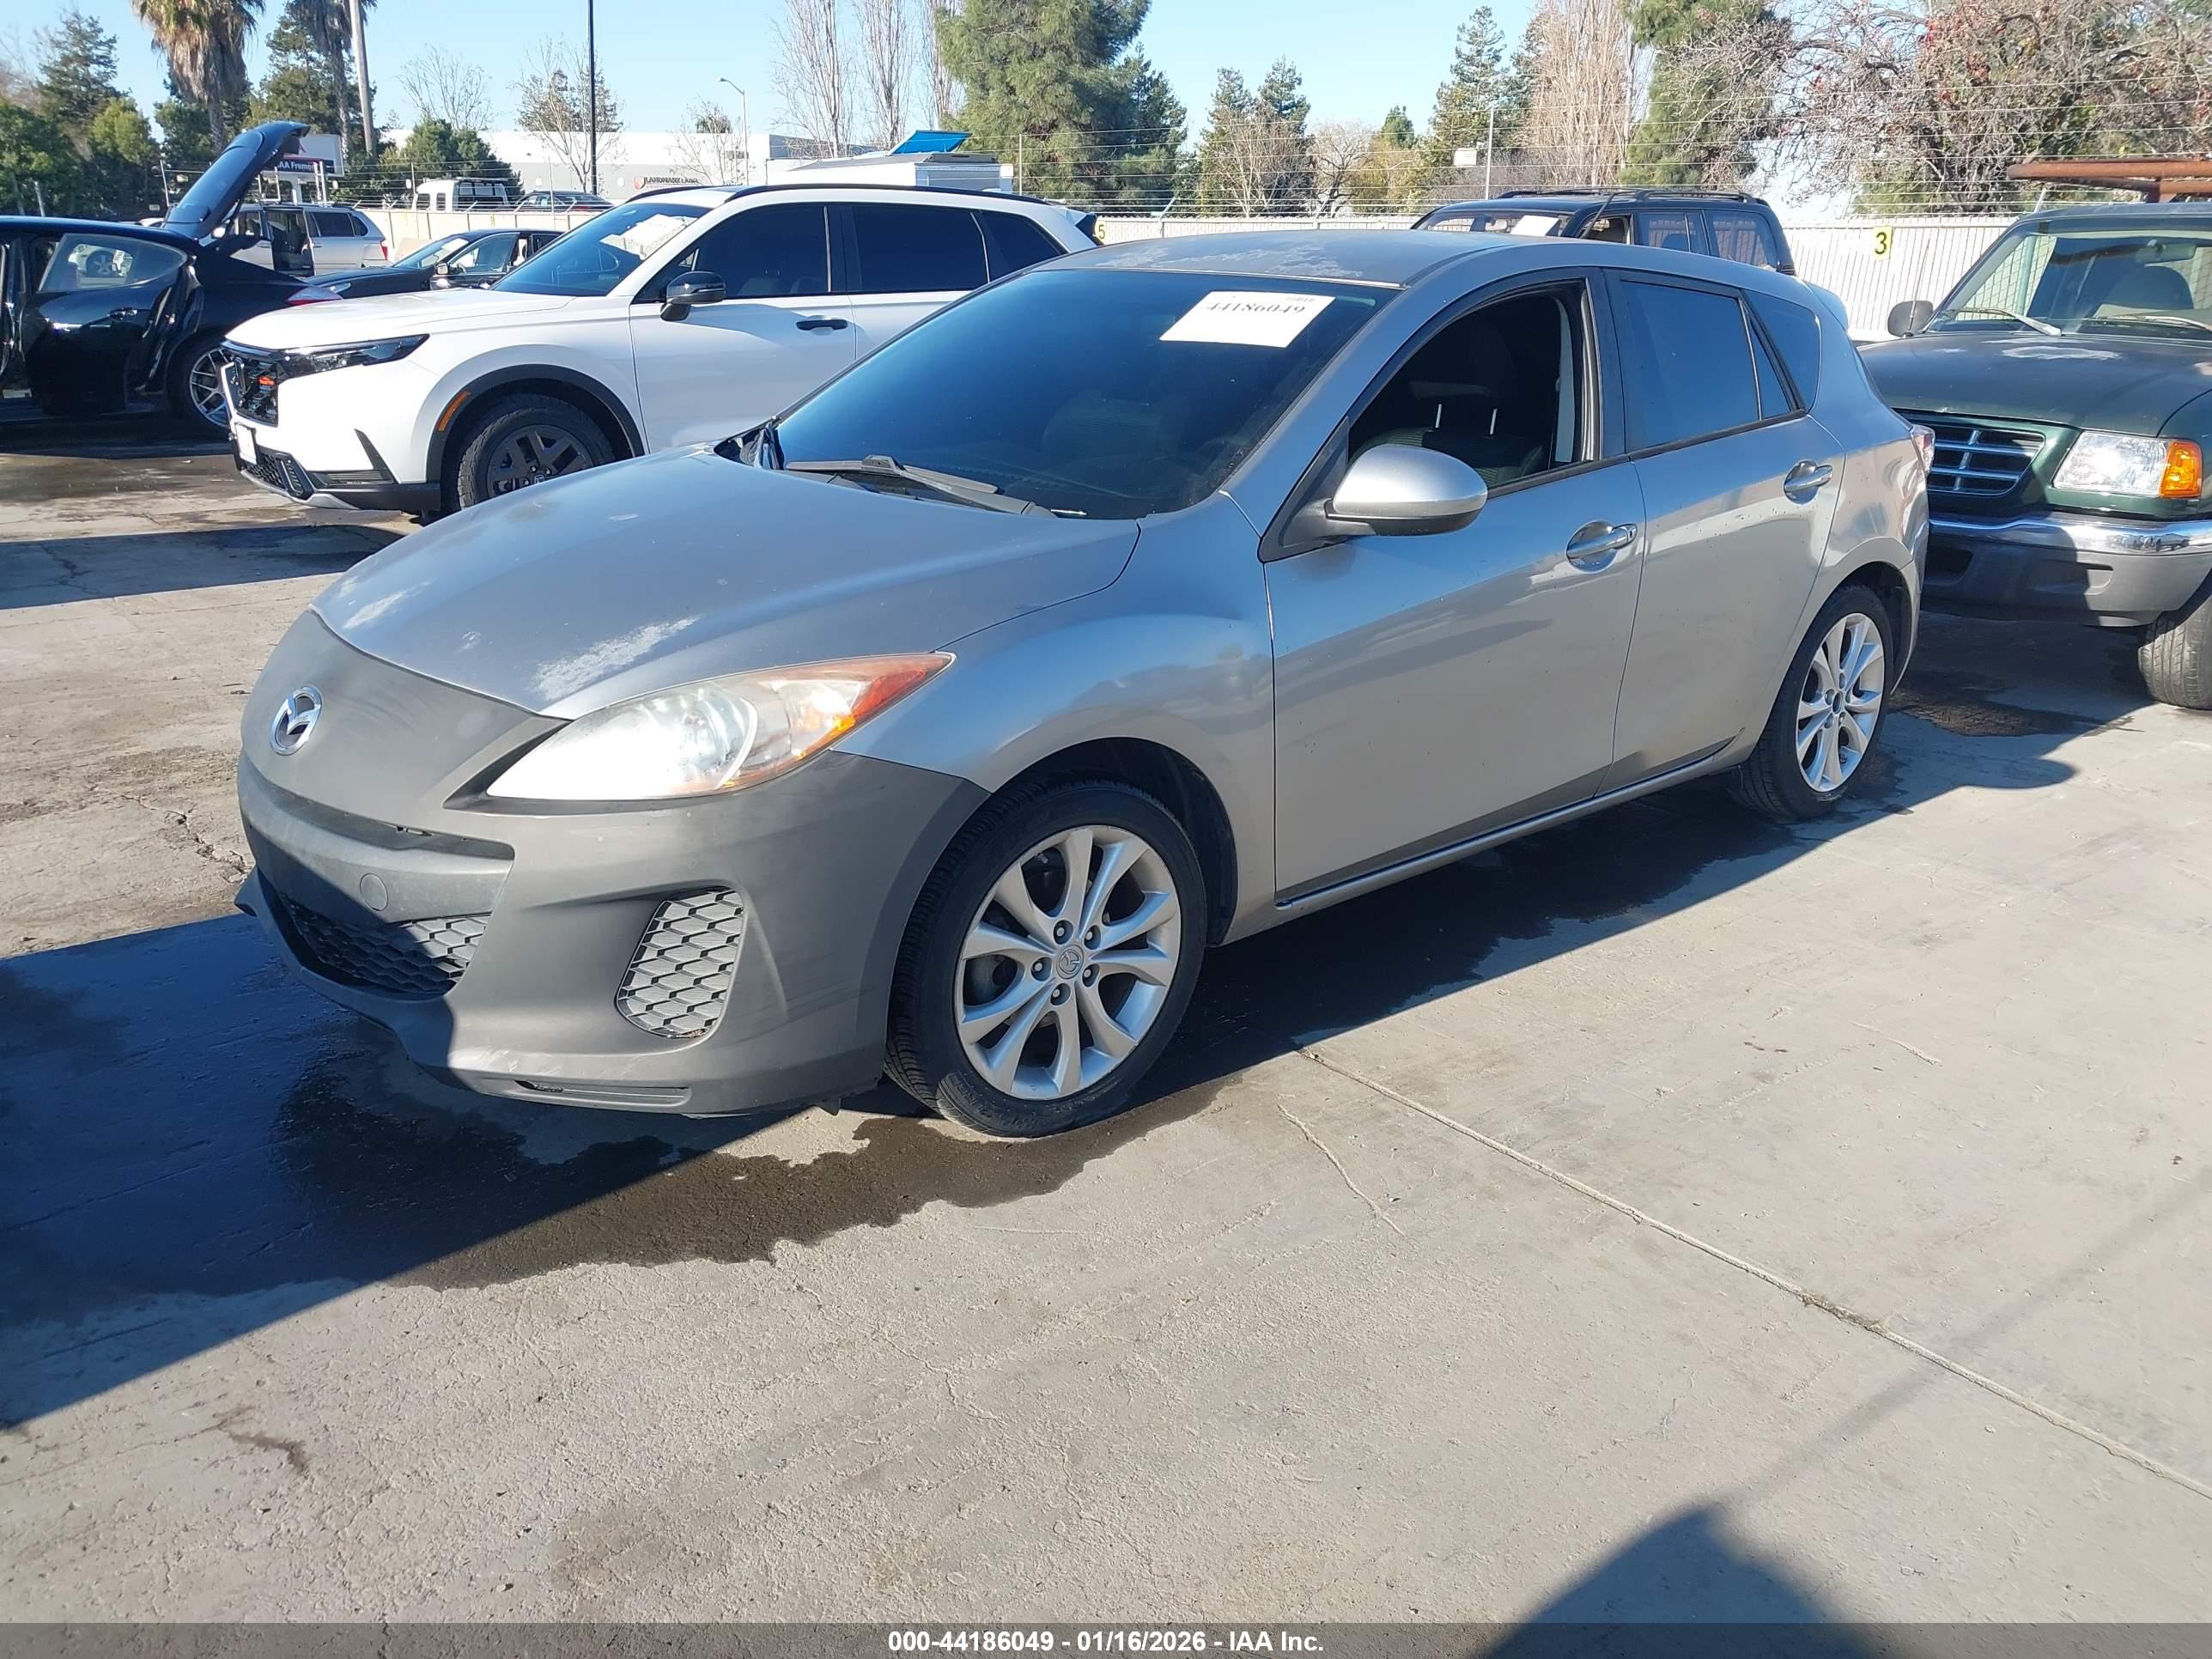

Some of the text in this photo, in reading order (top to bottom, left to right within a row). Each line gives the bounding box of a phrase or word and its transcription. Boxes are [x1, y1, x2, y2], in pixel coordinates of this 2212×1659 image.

[1098, 224, 1105, 240] 5
[1875, 232, 1887, 254] 3
[1206, 302, 1306, 313] 44186049
